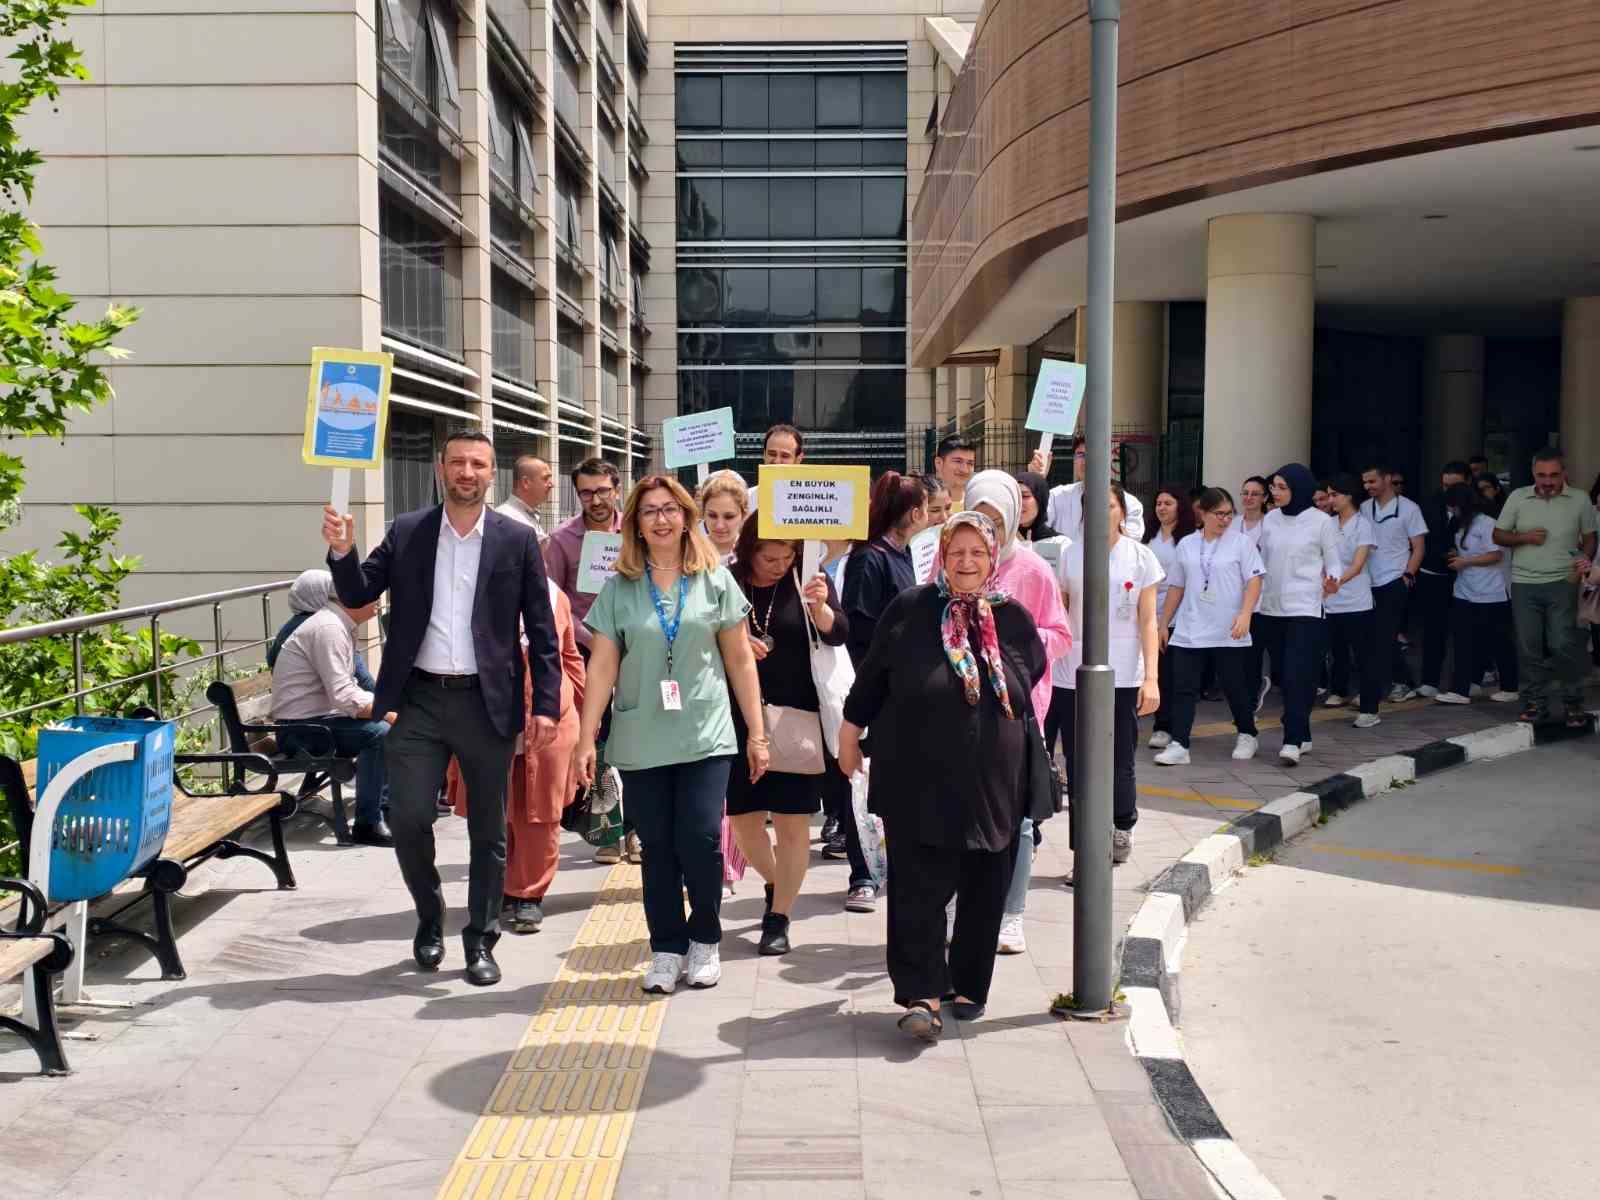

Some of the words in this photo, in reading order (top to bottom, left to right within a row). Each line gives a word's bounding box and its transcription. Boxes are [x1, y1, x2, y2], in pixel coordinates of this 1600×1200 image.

[789, 480, 802, 488] EN
[804, 479, 836, 488] BÜYÜK
[786, 492, 839, 501] ZENGİNLİK,
[791, 504, 833, 513] SAĞLIKLI
